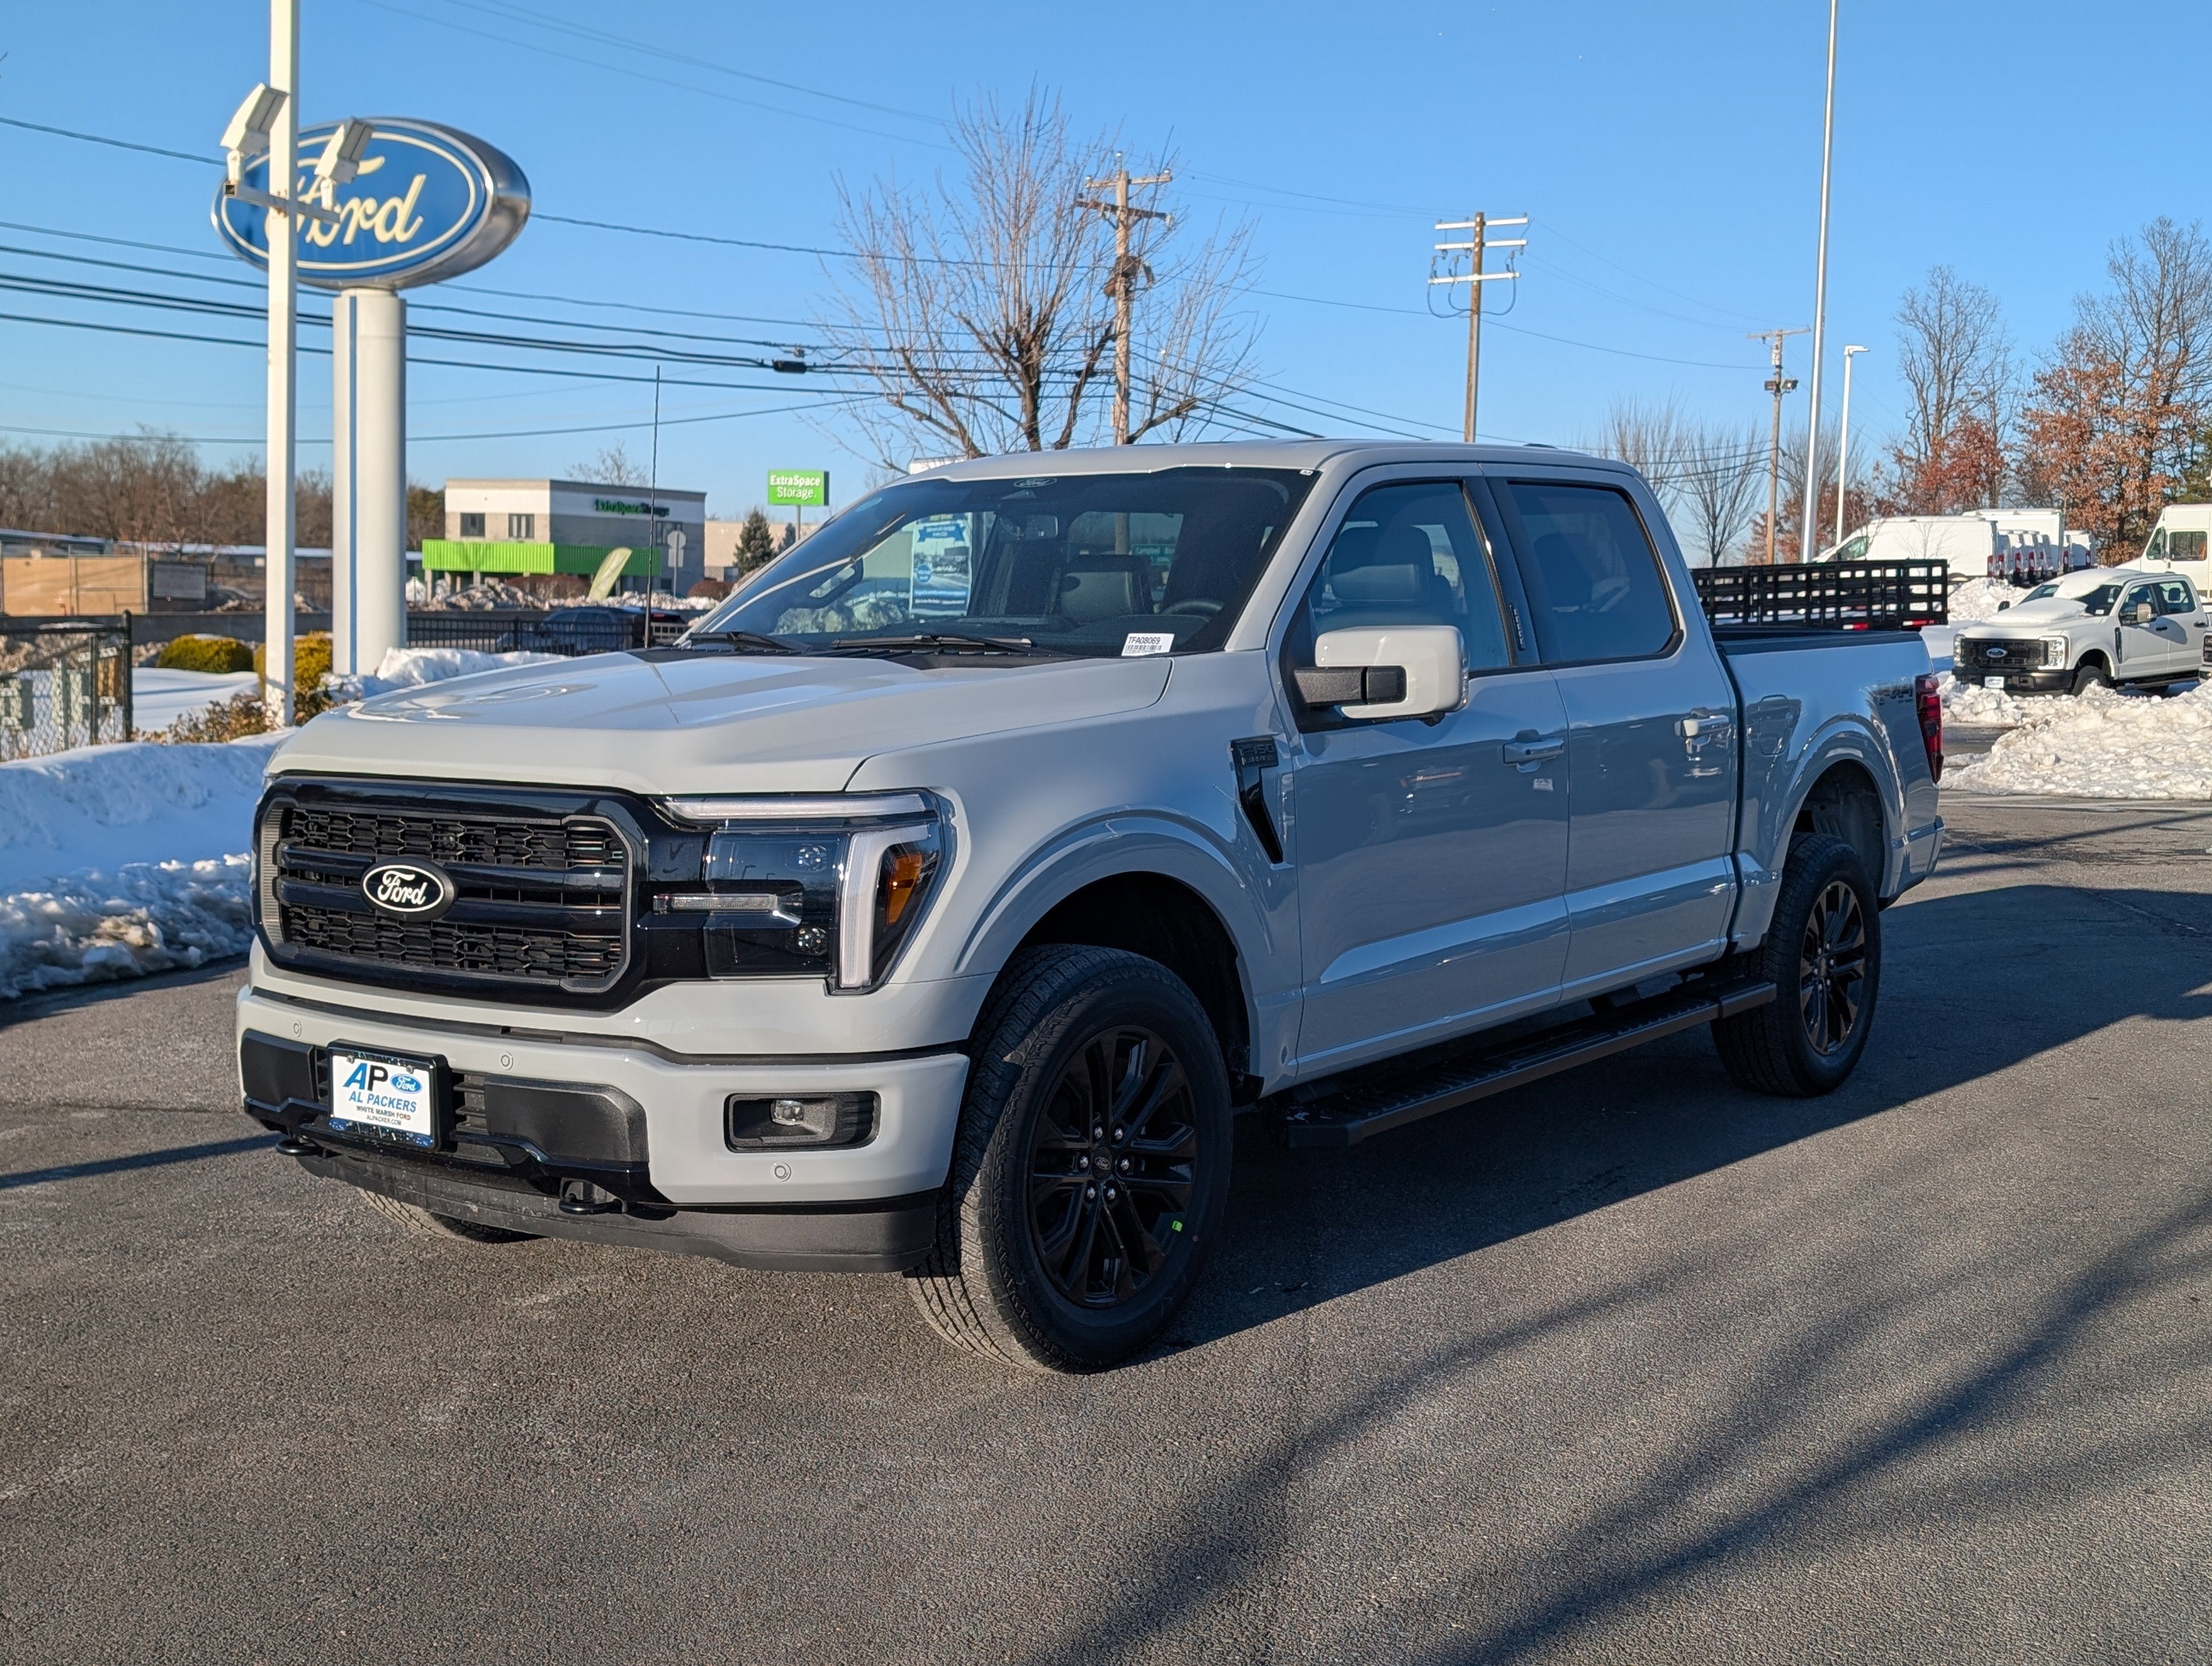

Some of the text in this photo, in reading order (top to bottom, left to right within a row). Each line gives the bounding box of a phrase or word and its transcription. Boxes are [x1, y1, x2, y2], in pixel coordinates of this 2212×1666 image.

[770, 475, 821, 487] ExtraSpace
[776, 486, 814, 500] Storage
[377, 870, 428, 905] Ford
[342, 1062, 417, 1092] AP Ford
[349, 1091, 417, 1113] AL PACKERS
[356, 1105, 411, 1121] WHITE MARSH FORD
